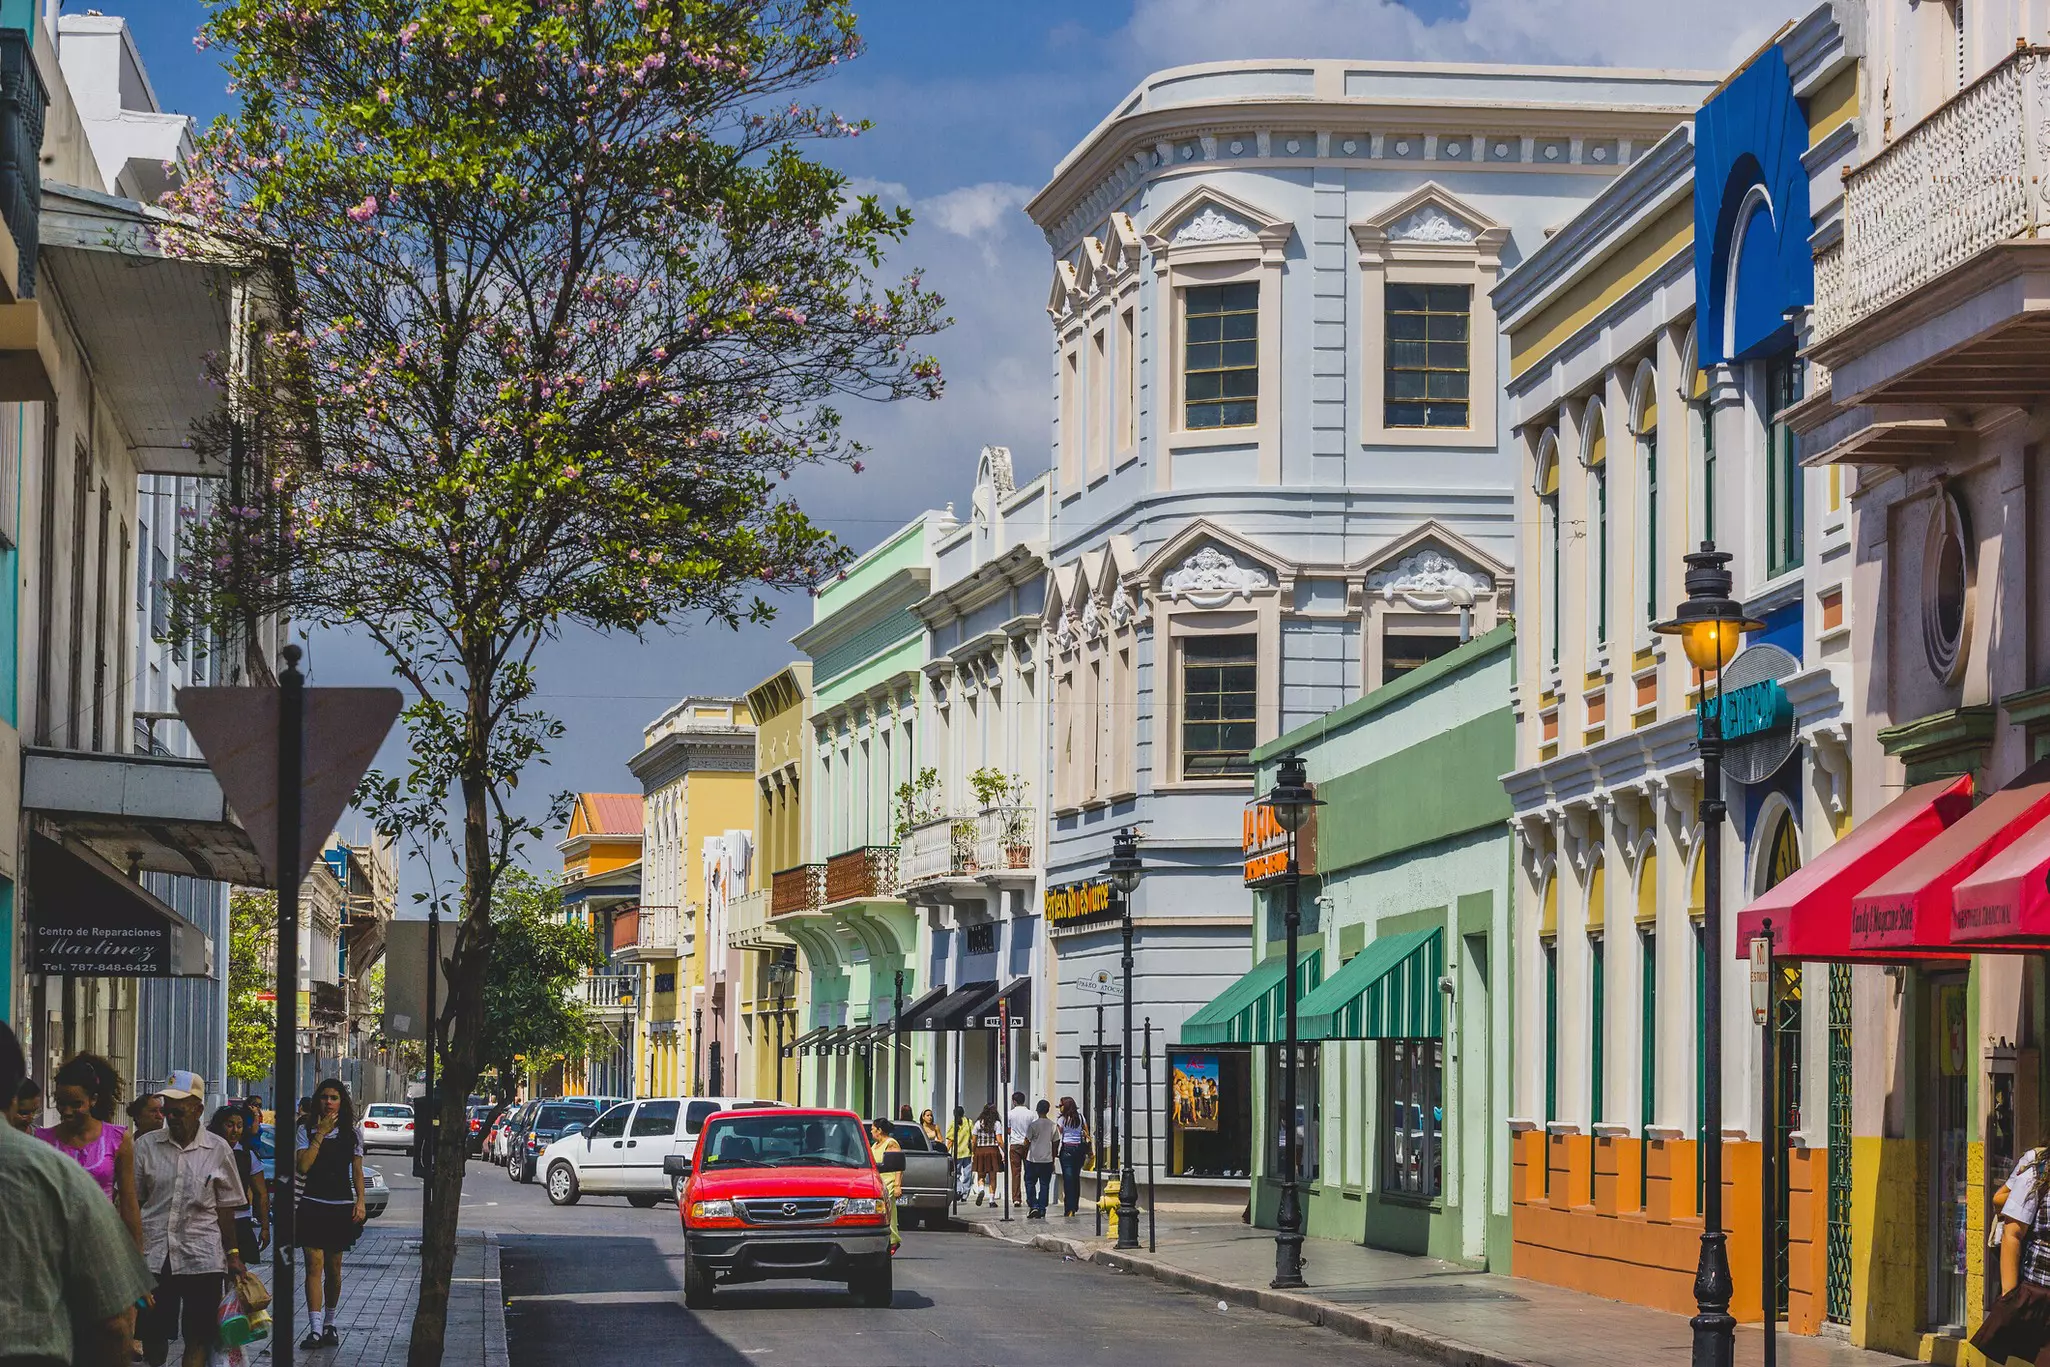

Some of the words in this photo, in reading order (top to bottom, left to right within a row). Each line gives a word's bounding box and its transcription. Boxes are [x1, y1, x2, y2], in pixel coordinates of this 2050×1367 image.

[1044, 889, 1067, 927] Payless
[39, 926, 73, 936] Centro
[76, 927, 88, 936] de
[92, 927, 161, 938] Reparaciones
[42, 963, 66, 971] Tel.
[71, 963, 157, 972] 787-848-6425
